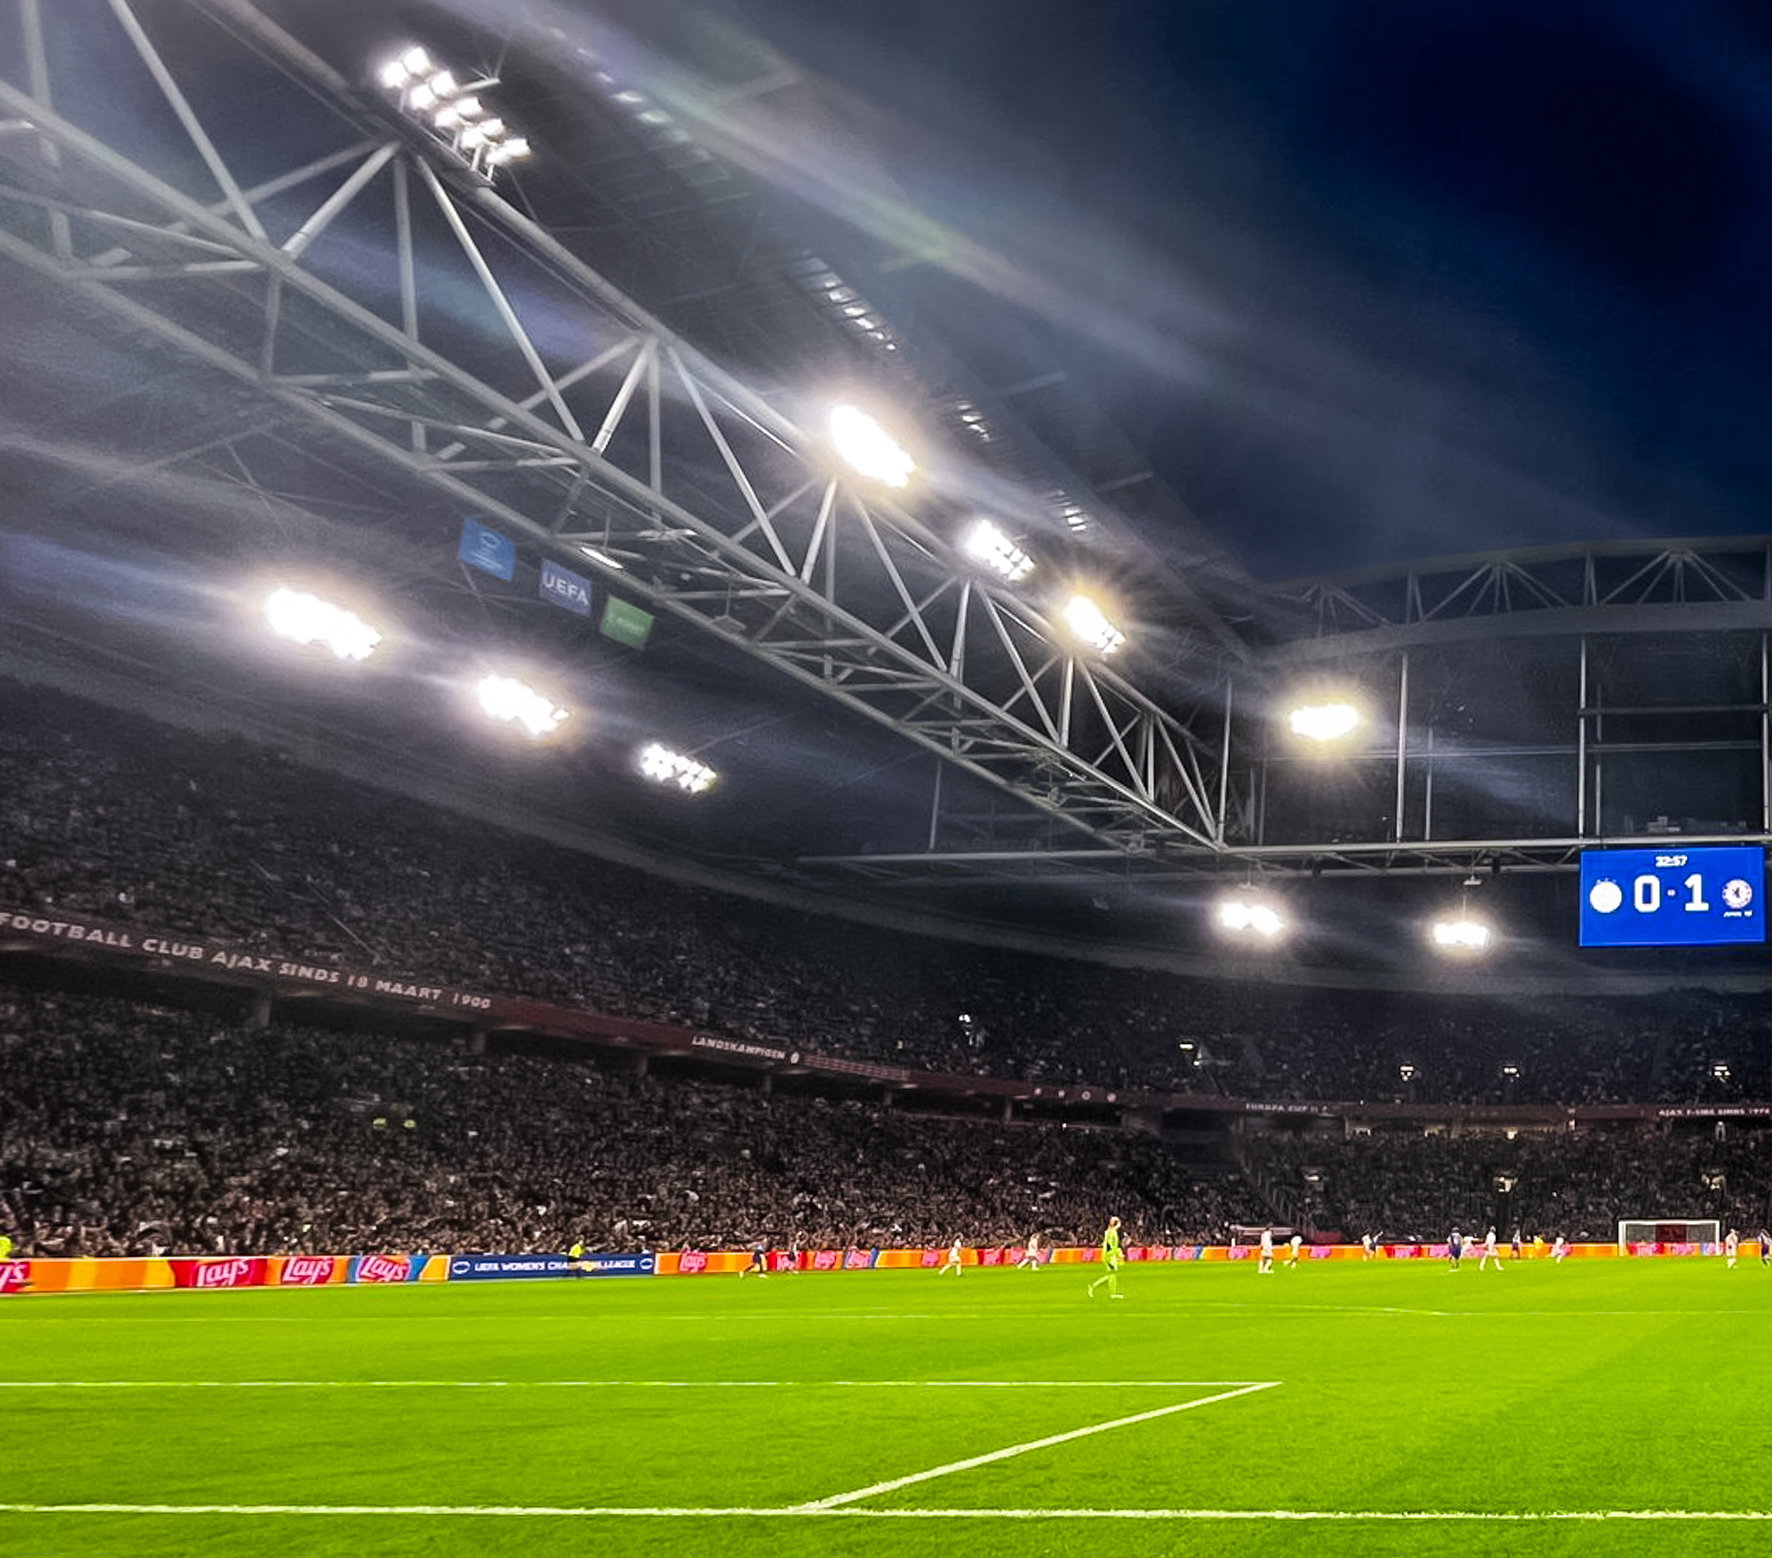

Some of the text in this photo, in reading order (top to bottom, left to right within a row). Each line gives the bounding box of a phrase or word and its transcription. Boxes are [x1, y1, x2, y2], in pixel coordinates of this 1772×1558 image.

[543, 571, 590, 607] UEFA
[1634, 874, 1660, 912] 0
[1684, 873, 1709, 911] 1
[0, 912, 492, 1009] FOOTBALL CLUB AJAX SINDS 18 MAART 1900
